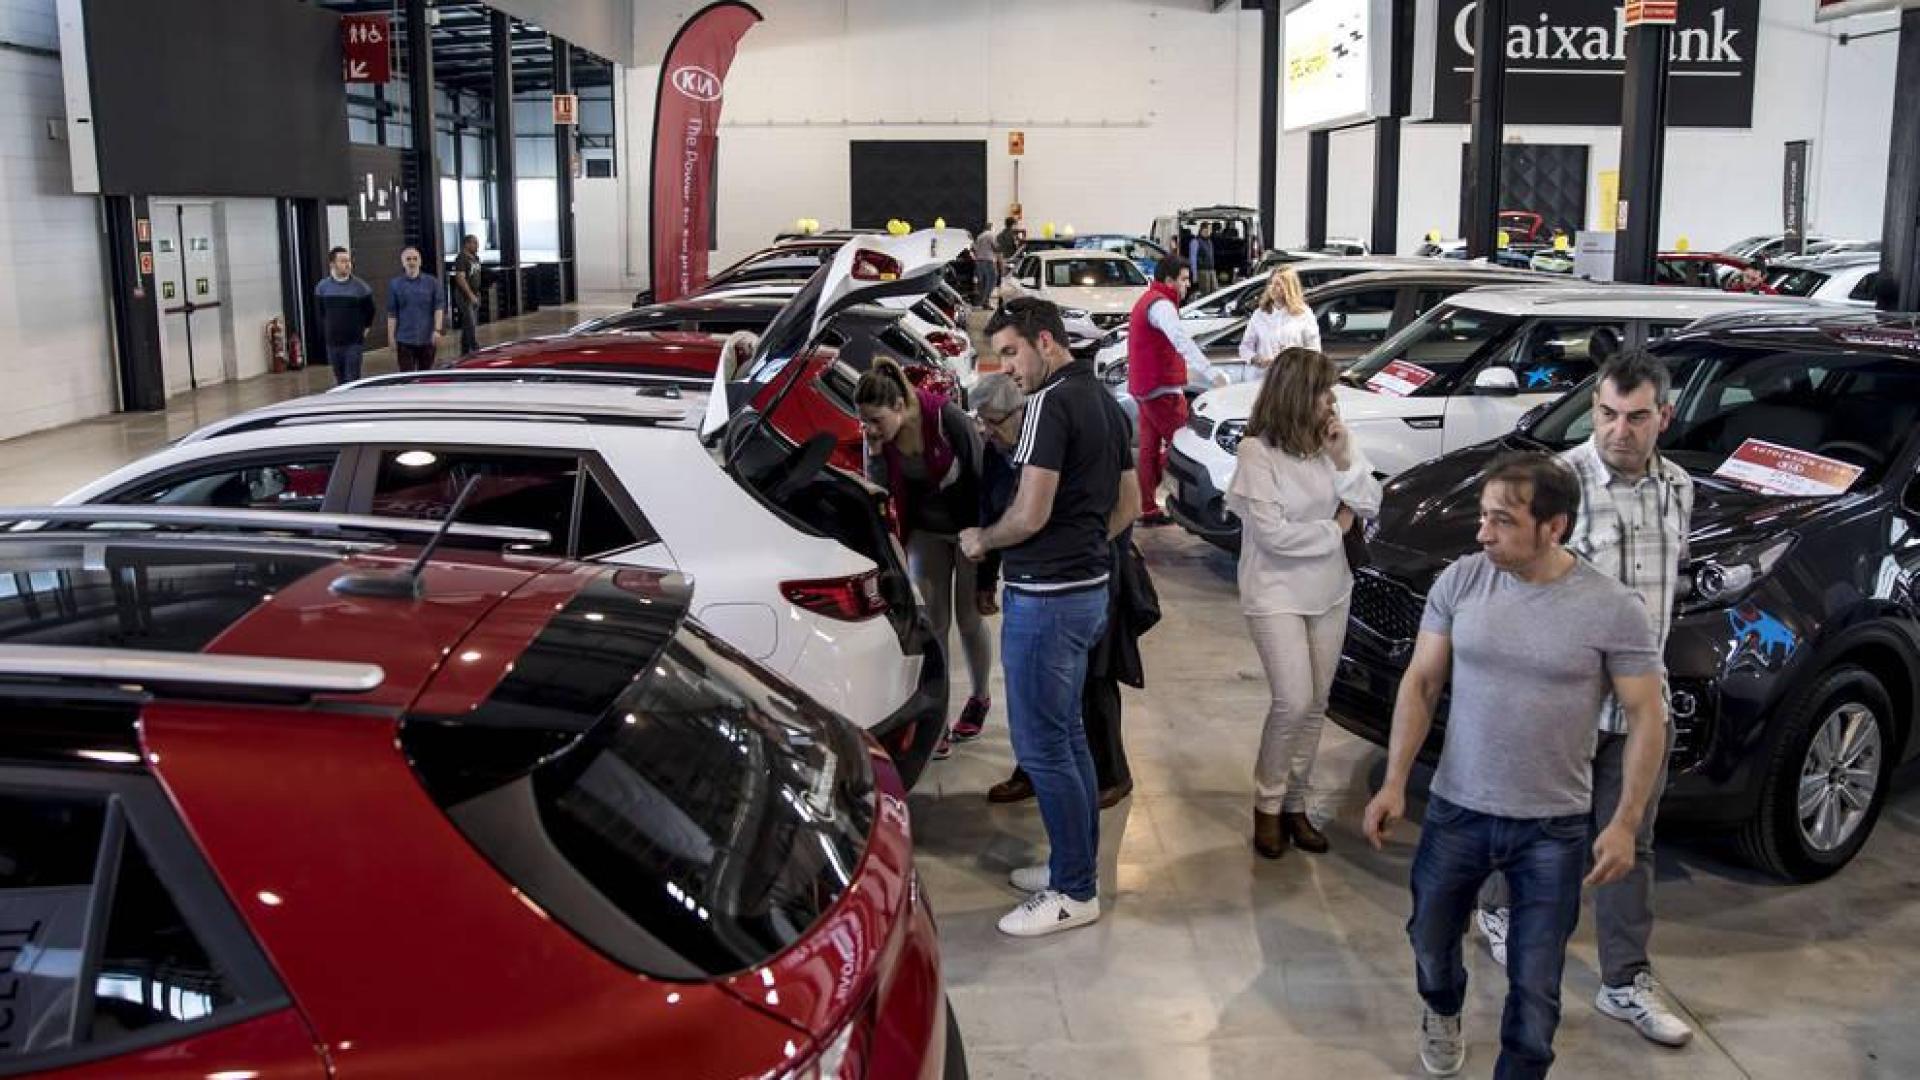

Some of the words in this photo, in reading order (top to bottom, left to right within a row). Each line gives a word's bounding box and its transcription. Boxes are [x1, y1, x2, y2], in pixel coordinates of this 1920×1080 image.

[1453, 1, 1743, 61] Caixank
[688, 118, 702, 146] The
[685, 150, 698, 201] Power
